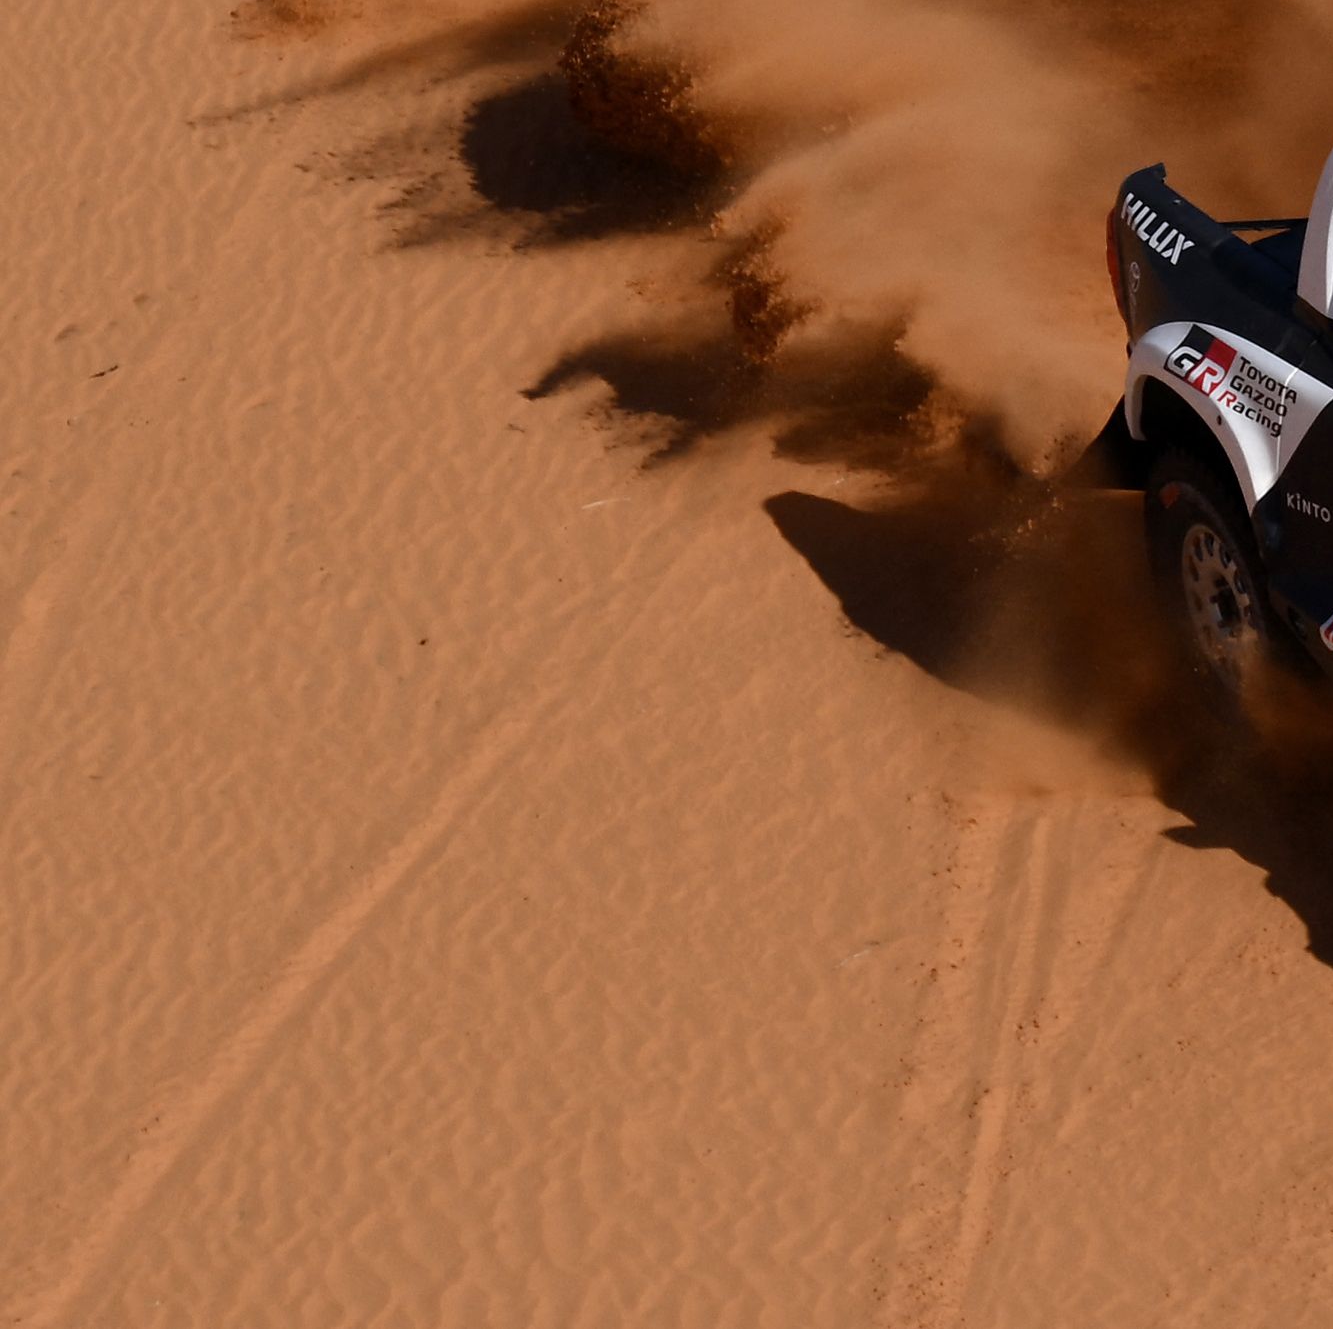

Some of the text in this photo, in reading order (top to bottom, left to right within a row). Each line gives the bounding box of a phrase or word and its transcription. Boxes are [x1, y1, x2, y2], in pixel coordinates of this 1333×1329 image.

[1120, 192, 1195, 265] HILUX
[1166, 345, 1226, 395] GR
[1239, 356, 1298, 405] TOYOTA
[1217, 390, 1283, 438] Racing
[1229, 374, 1288, 418] GAZOO
